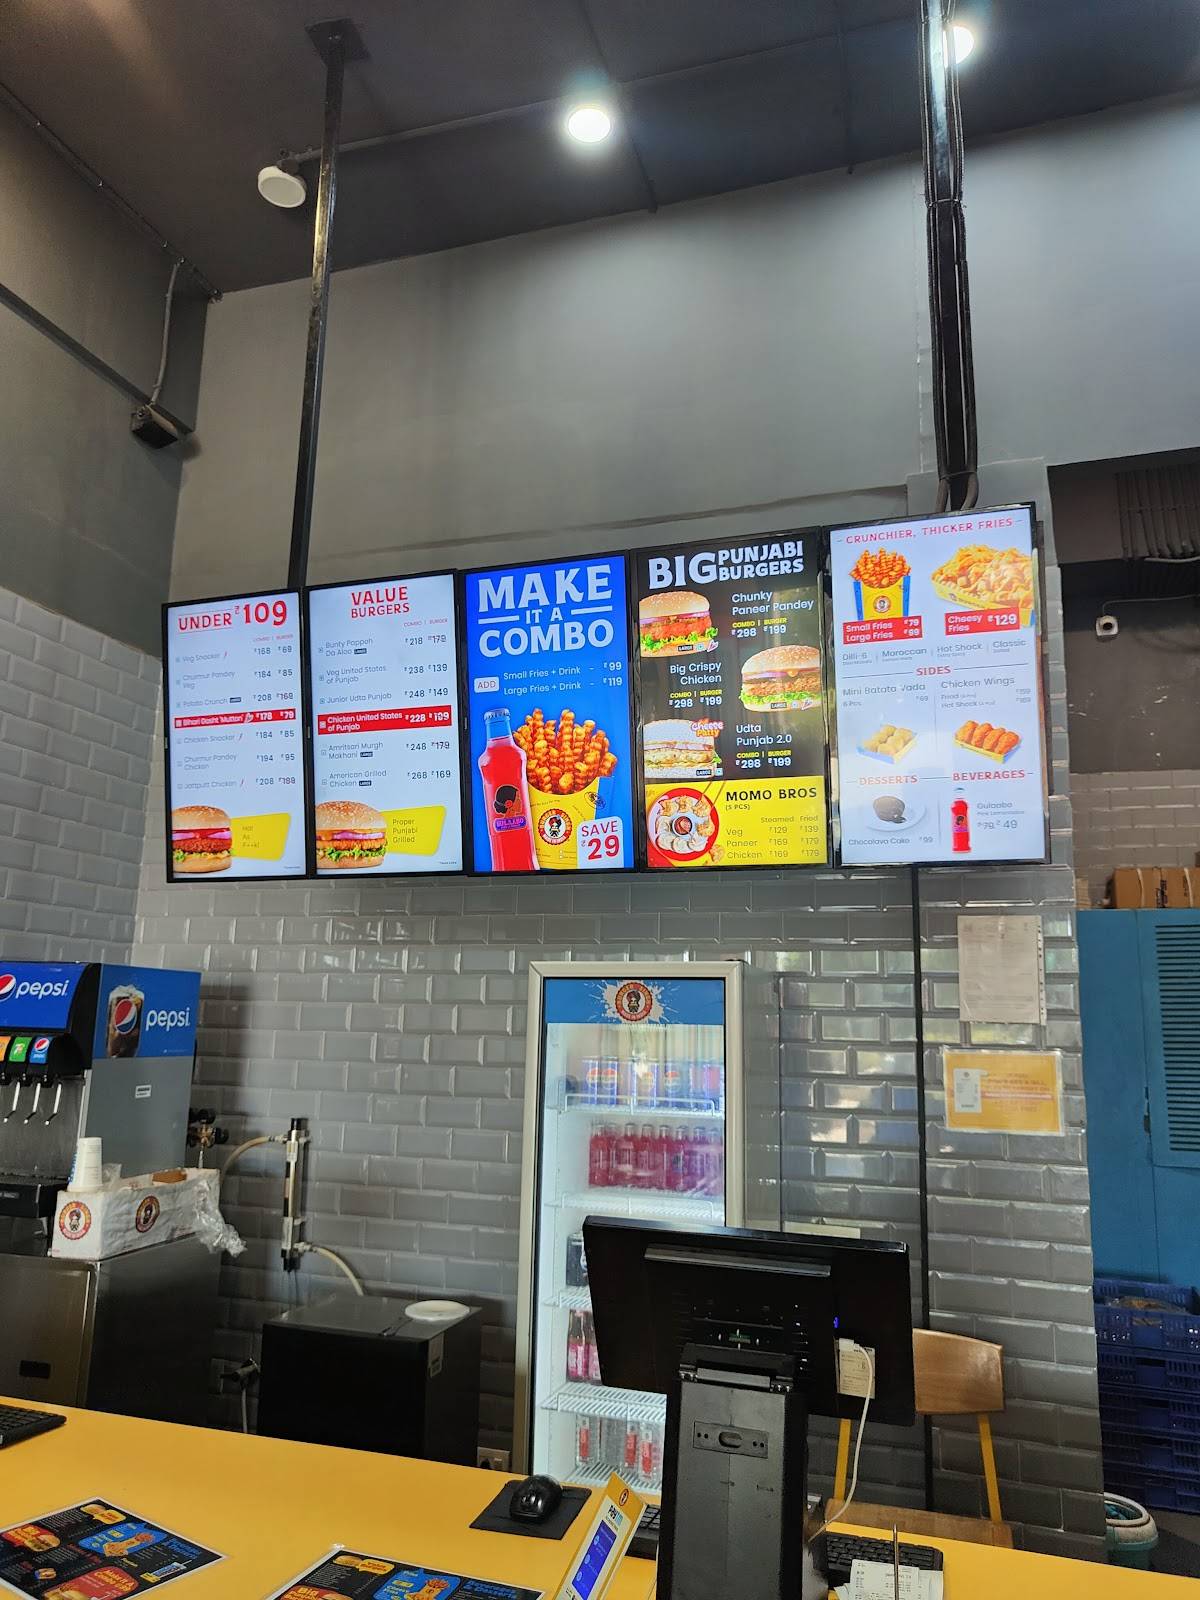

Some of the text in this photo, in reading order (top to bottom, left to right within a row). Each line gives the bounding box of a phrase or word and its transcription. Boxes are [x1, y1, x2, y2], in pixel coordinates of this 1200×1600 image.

[846, 518, 1013, 544] CRUNCHIER, THICKER FRIES
[648, 541, 803, 589] BIG PUNJABI
[719, 558, 804, 581] BURGERS
[478, 564, 612, 613] MAKE
[351, 586, 408, 606] VALUE
[732, 591, 773, 603] Chunky
[351, 603, 410, 619] BURGERS
[732, 600, 814, 615] Paneer Pandey
[526, 607, 563, 624] IT A
[947, 614, 983, 625] Cheesy
[178, 613, 232, 631] UNDER
[732, 620, 755, 628] COMBO
[846, 623, 870, 632] Small
[872, 621, 893, 630] Fries
[948, 624, 970, 632] Fries
[479, 619, 614, 658] COMBO
[846, 634, 871, 643] Large
[872, 632, 893, 640] Fries
[325, 641, 345, 649] Bunty
[937, 639, 1026, 653] Hot Shock Classic
[882, 647, 927, 657] Moroccan
[326, 669, 340, 677] Veg
[503, 671, 528, 680] Small
[529, 669, 549, 679] Fries
[558, 666, 581, 676] Drink
[670, 662, 721, 674] Big Crispy
[916, 666, 951, 676] SIDES
[335, 675, 359, 684] Punjab
[477, 681, 496, 689] ADD
[681, 674, 721, 685] Chicken
[941, 677, 1015, 689] Chicken Wings
[503, 686, 528, 696] Large
[529, 684, 550, 693] Fries
[559, 682, 581, 691] Drink
[842, 687, 862, 697] Mini
[864, 684, 897, 695] Batata
[327, 695, 349, 703] Junior
[367, 692, 392, 702] Punjab
[327, 715, 356, 723] Chicken
[356, 713, 380, 722] United
[336, 723, 361, 732] Punjab
[691, 721, 724, 731] Cheese
[736, 724, 761, 734] Udta
[696, 728, 720, 737] Patty
[361, 741, 383, 750] Murgh
[736, 734, 792, 747] Punjab 2.0
[329, 751, 358, 759] Makhani
[330, 771, 362, 779] American
[859, 775, 918, 785] DESSERTS
[953, 770, 1025, 781] BEVERAGES
[726, 788, 817, 801] MOMO BROS
[392, 818, 415, 826] Proper
[761, 815, 795, 824] Steamed
[392, 827, 418, 835] Punjabi
[581, 820, 618, 838] SAVE
[726, 828, 743, 837] Veg
[726, 839, 758, 847] Paneer
[848, 837, 889, 846] Chocolava
[890, 836, 910, 844] Cake
[727, 850, 762, 859] Chicken
[16, 980, 70, 999] pepsi
[145, 1007, 190, 1031] pepsi
